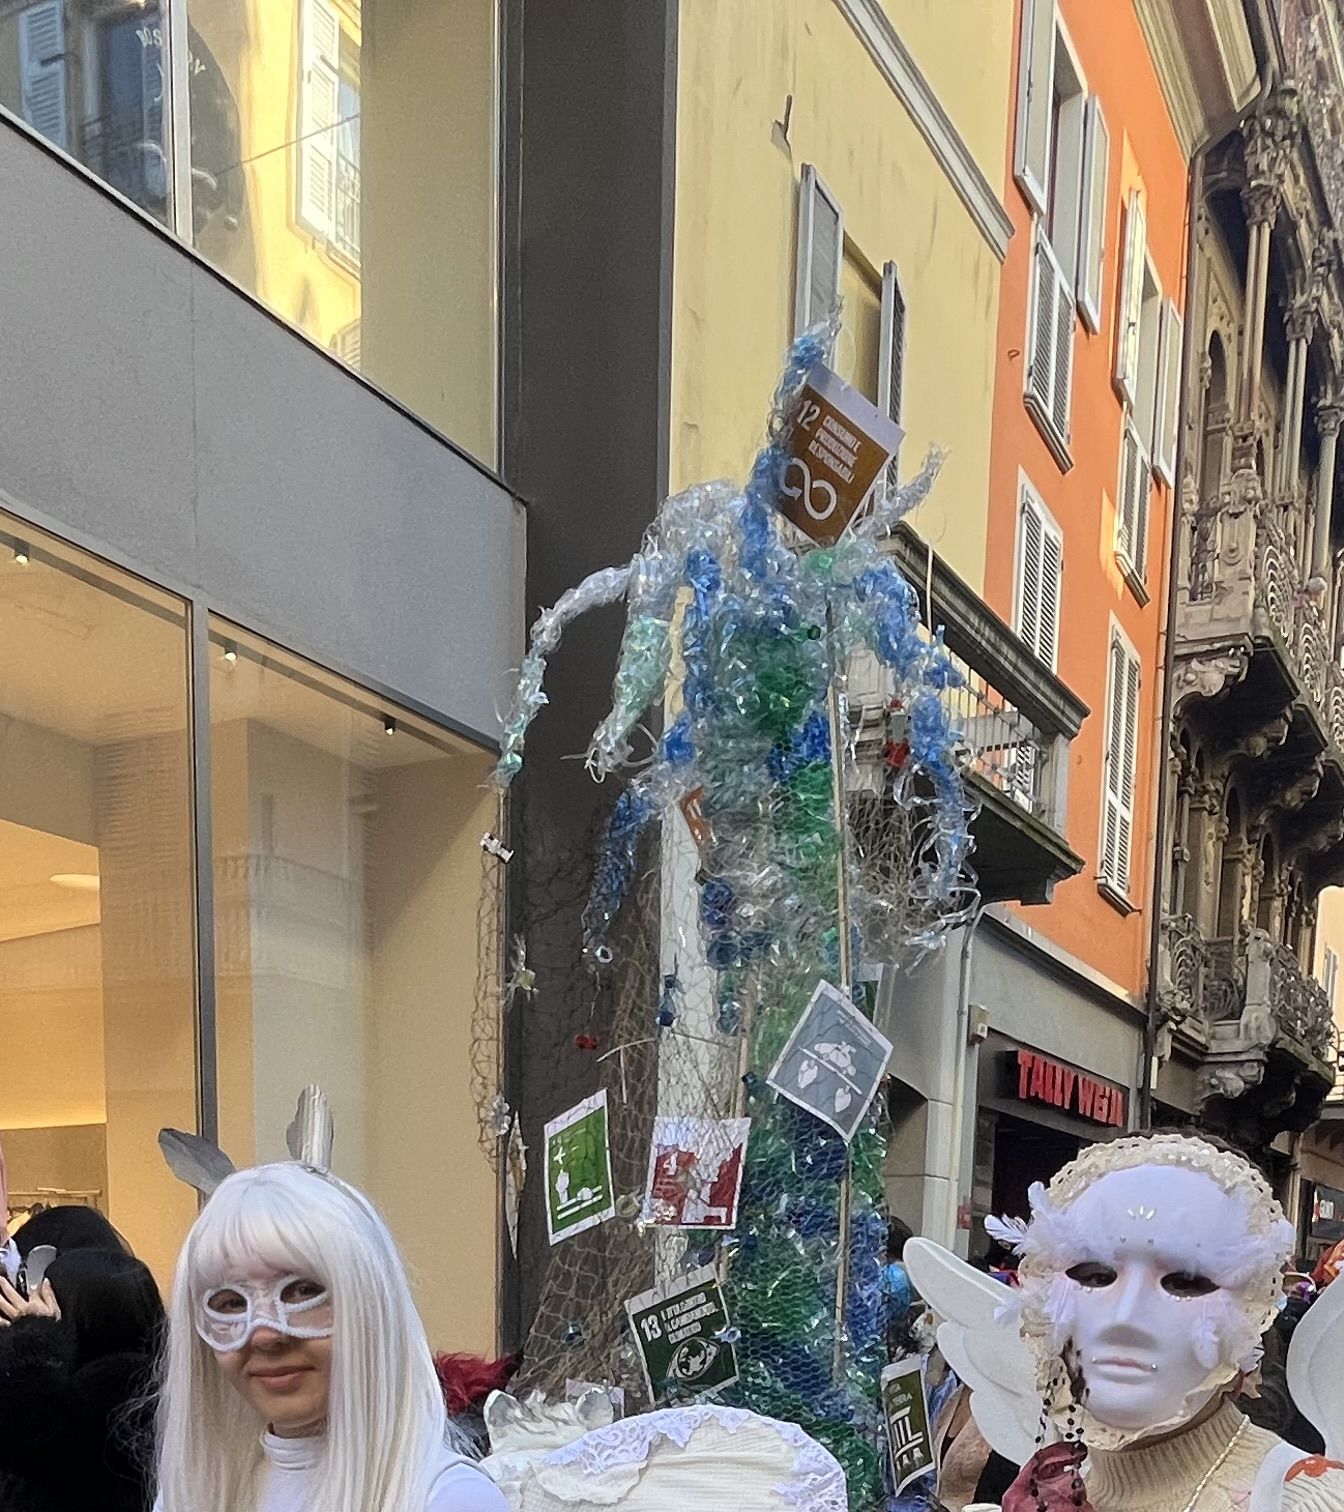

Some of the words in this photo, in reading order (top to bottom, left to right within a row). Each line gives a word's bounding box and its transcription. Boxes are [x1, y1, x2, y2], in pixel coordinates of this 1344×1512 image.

[797, 400, 821, 432] 12
[1017, 1049, 1076, 1110] TALLY
[640, 1314, 662, 1342] 13
